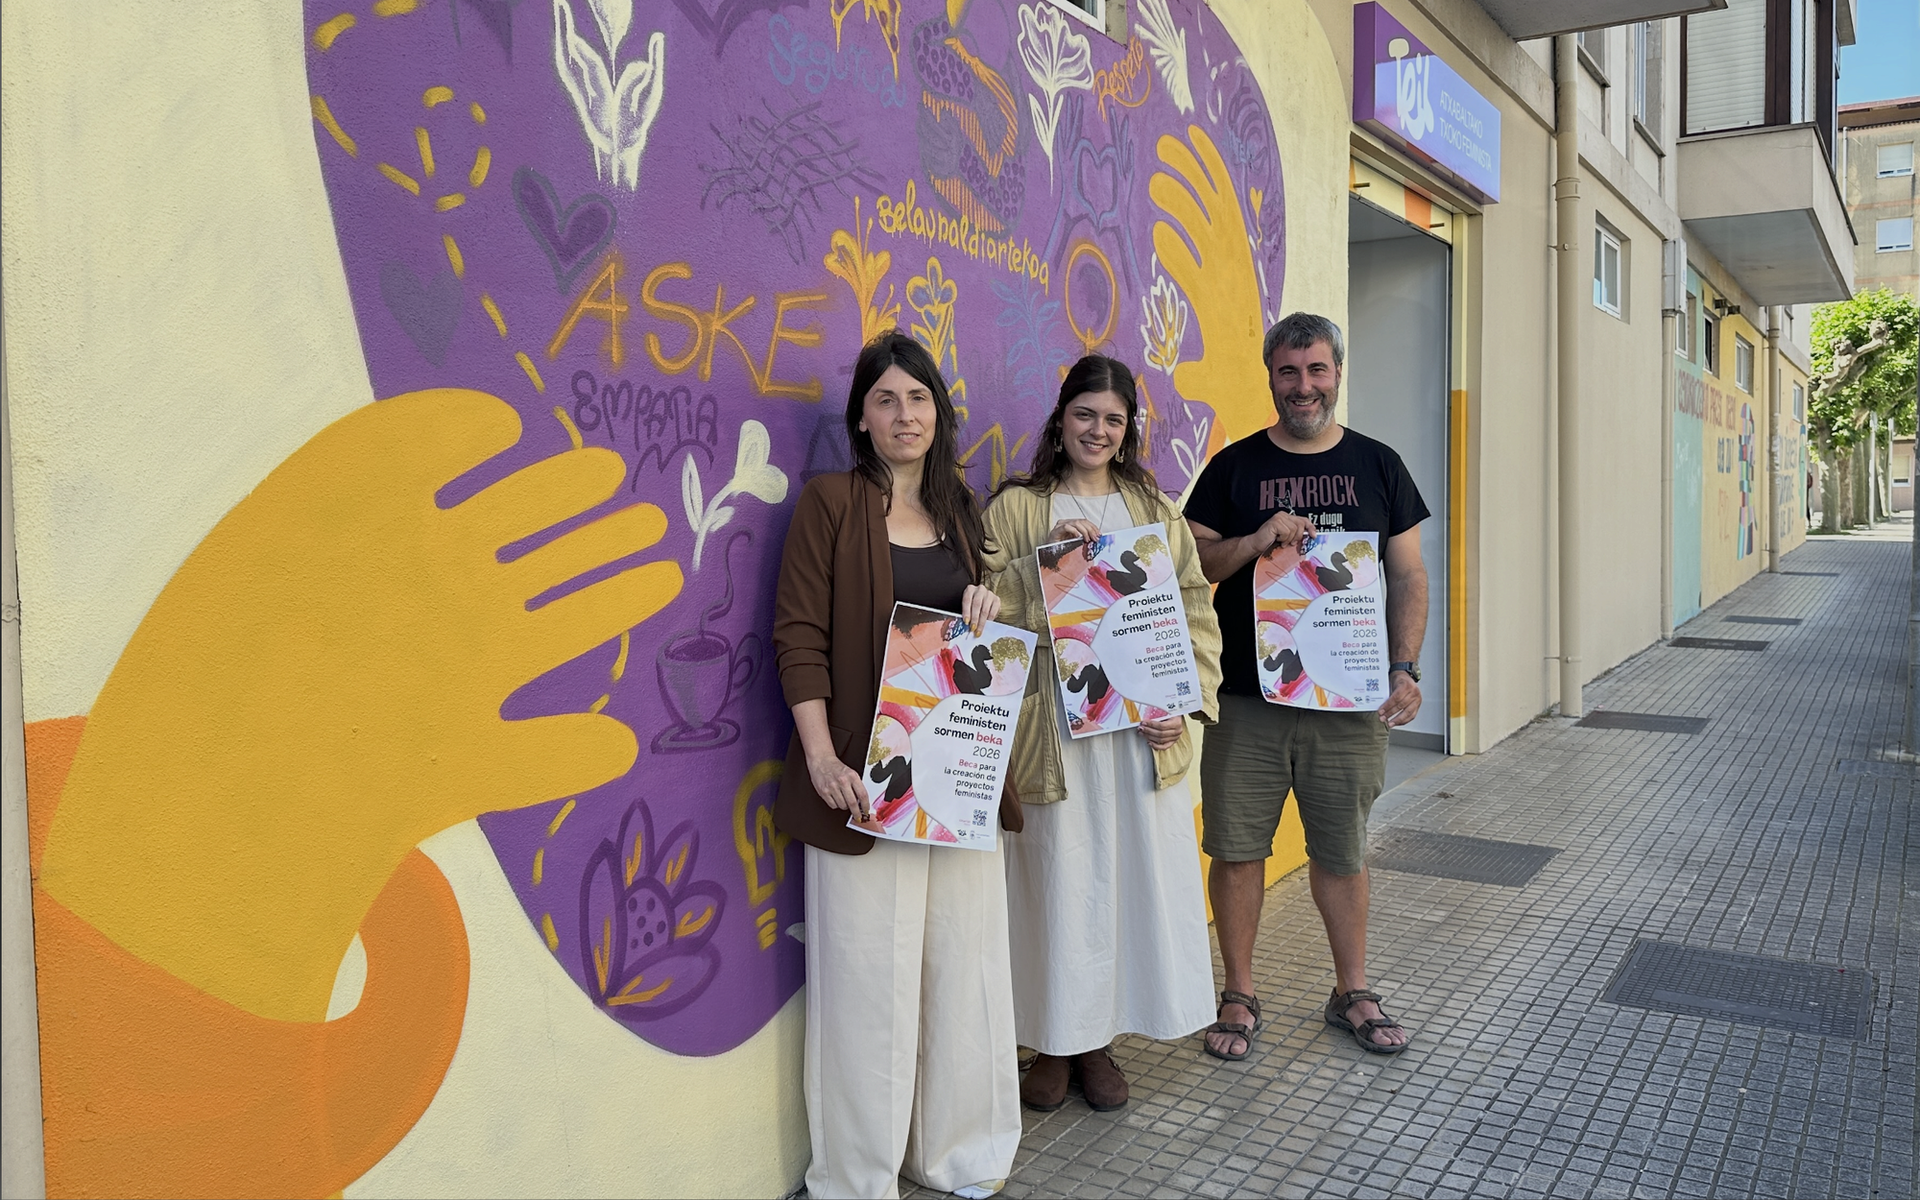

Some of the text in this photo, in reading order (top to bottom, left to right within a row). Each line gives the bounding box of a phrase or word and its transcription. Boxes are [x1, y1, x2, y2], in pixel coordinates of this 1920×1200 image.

[1092, 36, 1147, 121] Respeto
[1440, 90, 1483, 139] ATXABALTAKO
[1440, 117, 1492, 173] TXOKO FEMINISTA
[546, 256, 828, 402] ASKE
[1320, 512, 1343, 527] dugu
[1128, 593, 1173, 608] Proiektu
[1332, 595, 1375, 604] Proiektu
[1122, 605, 1176, 622] feministen
[1324, 607, 1376, 616] feministen
[1112, 618, 1178, 638] sormen beka
[1313, 618, 1376, 628] sormen beka
[1155, 628, 1181, 641] 2026
[1353, 629, 1378, 638] 2026
[1146, 642, 1182, 654] Beca para
[1143, 652, 1175, 663] creación
[1151, 658, 1187, 671] proyectos
[1152, 667, 1189, 678] feministas
[1344, 664, 1380, 672] feministas
[961, 699, 1010, 718] Proiektu
[949, 712, 1007, 732] feministen
[934, 726, 1003, 746] sormen beka
[972, 746, 1001, 760] 2026
[958, 759, 996, 773] Beca para
[944, 767, 996, 782] la creación de
[956, 780, 995, 792] proyectos
[954, 788, 993, 801] feministas
